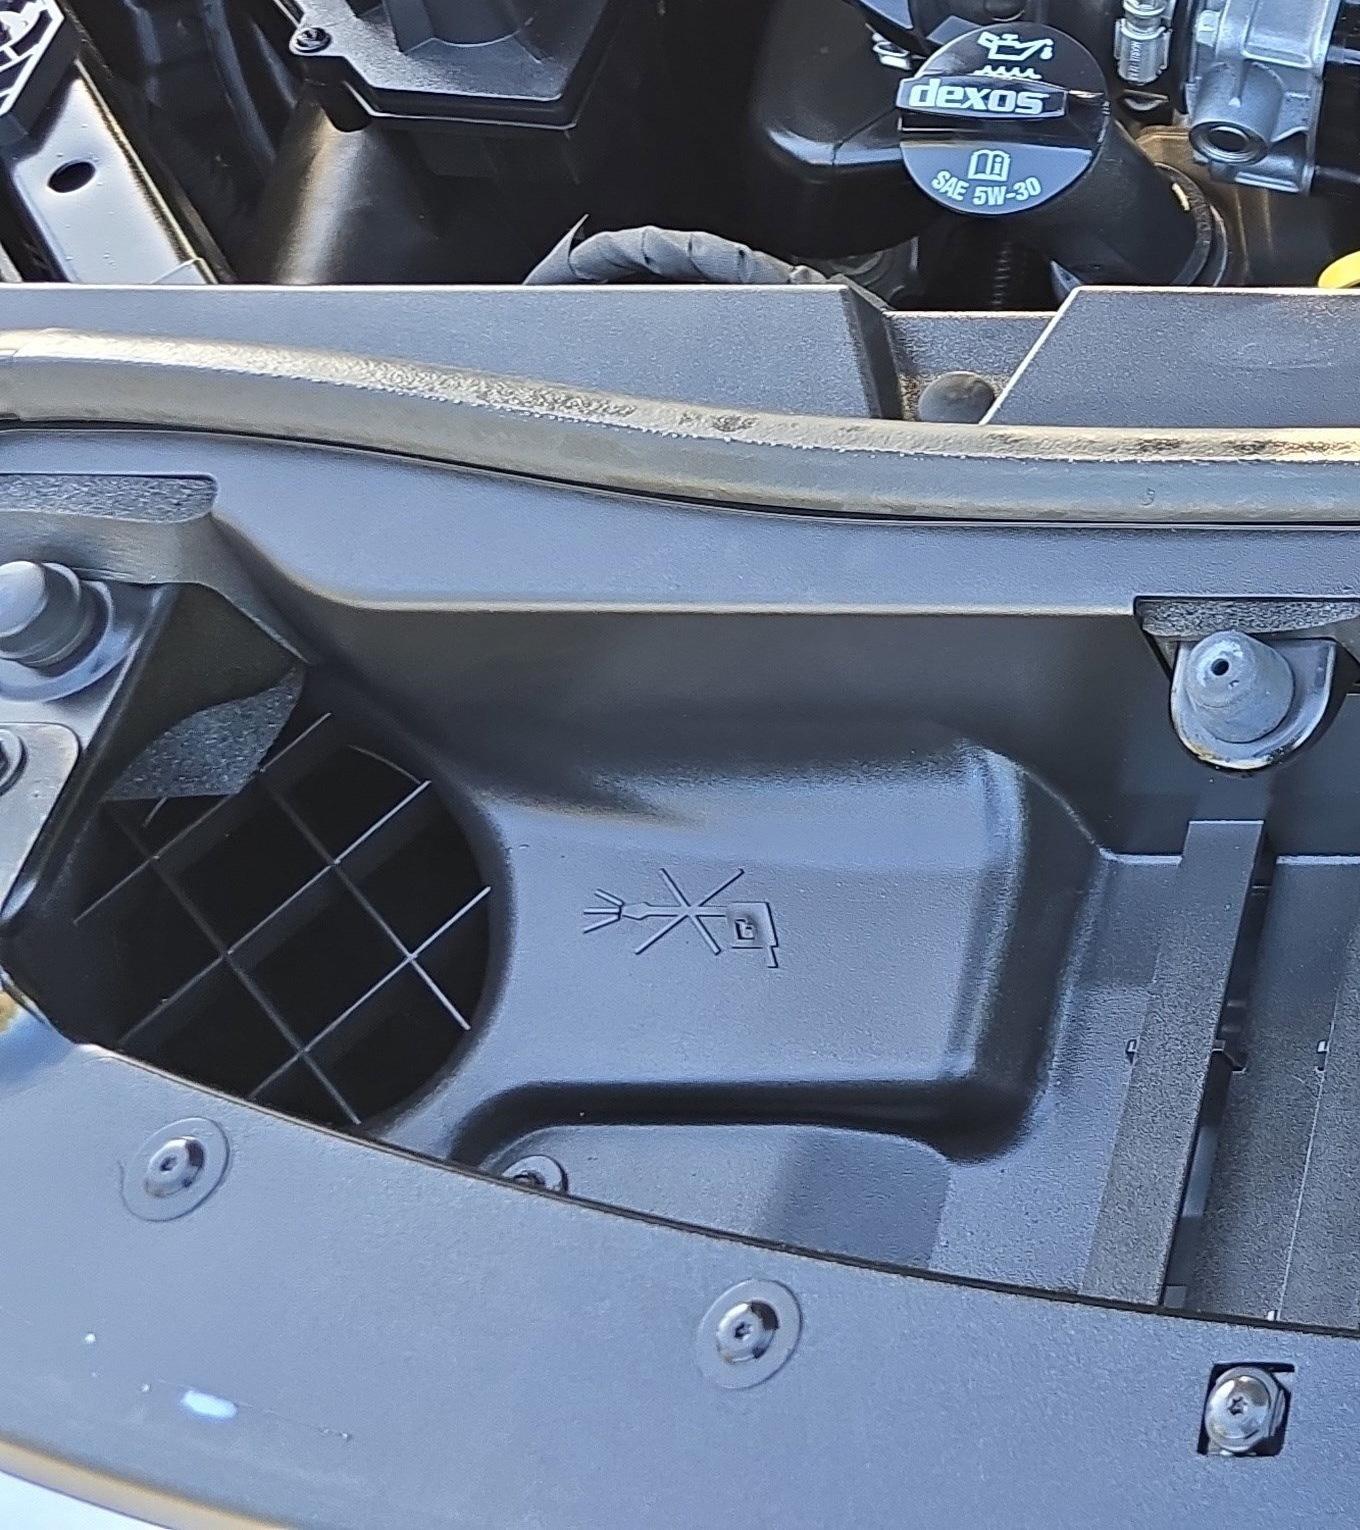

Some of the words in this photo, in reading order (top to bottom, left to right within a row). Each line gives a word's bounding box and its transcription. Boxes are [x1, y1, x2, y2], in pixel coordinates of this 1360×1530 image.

[908, 78, 1050, 114] dexos
[930, 170, 970, 201] SAE
[972, 176, 1042, 207] 5W-30
